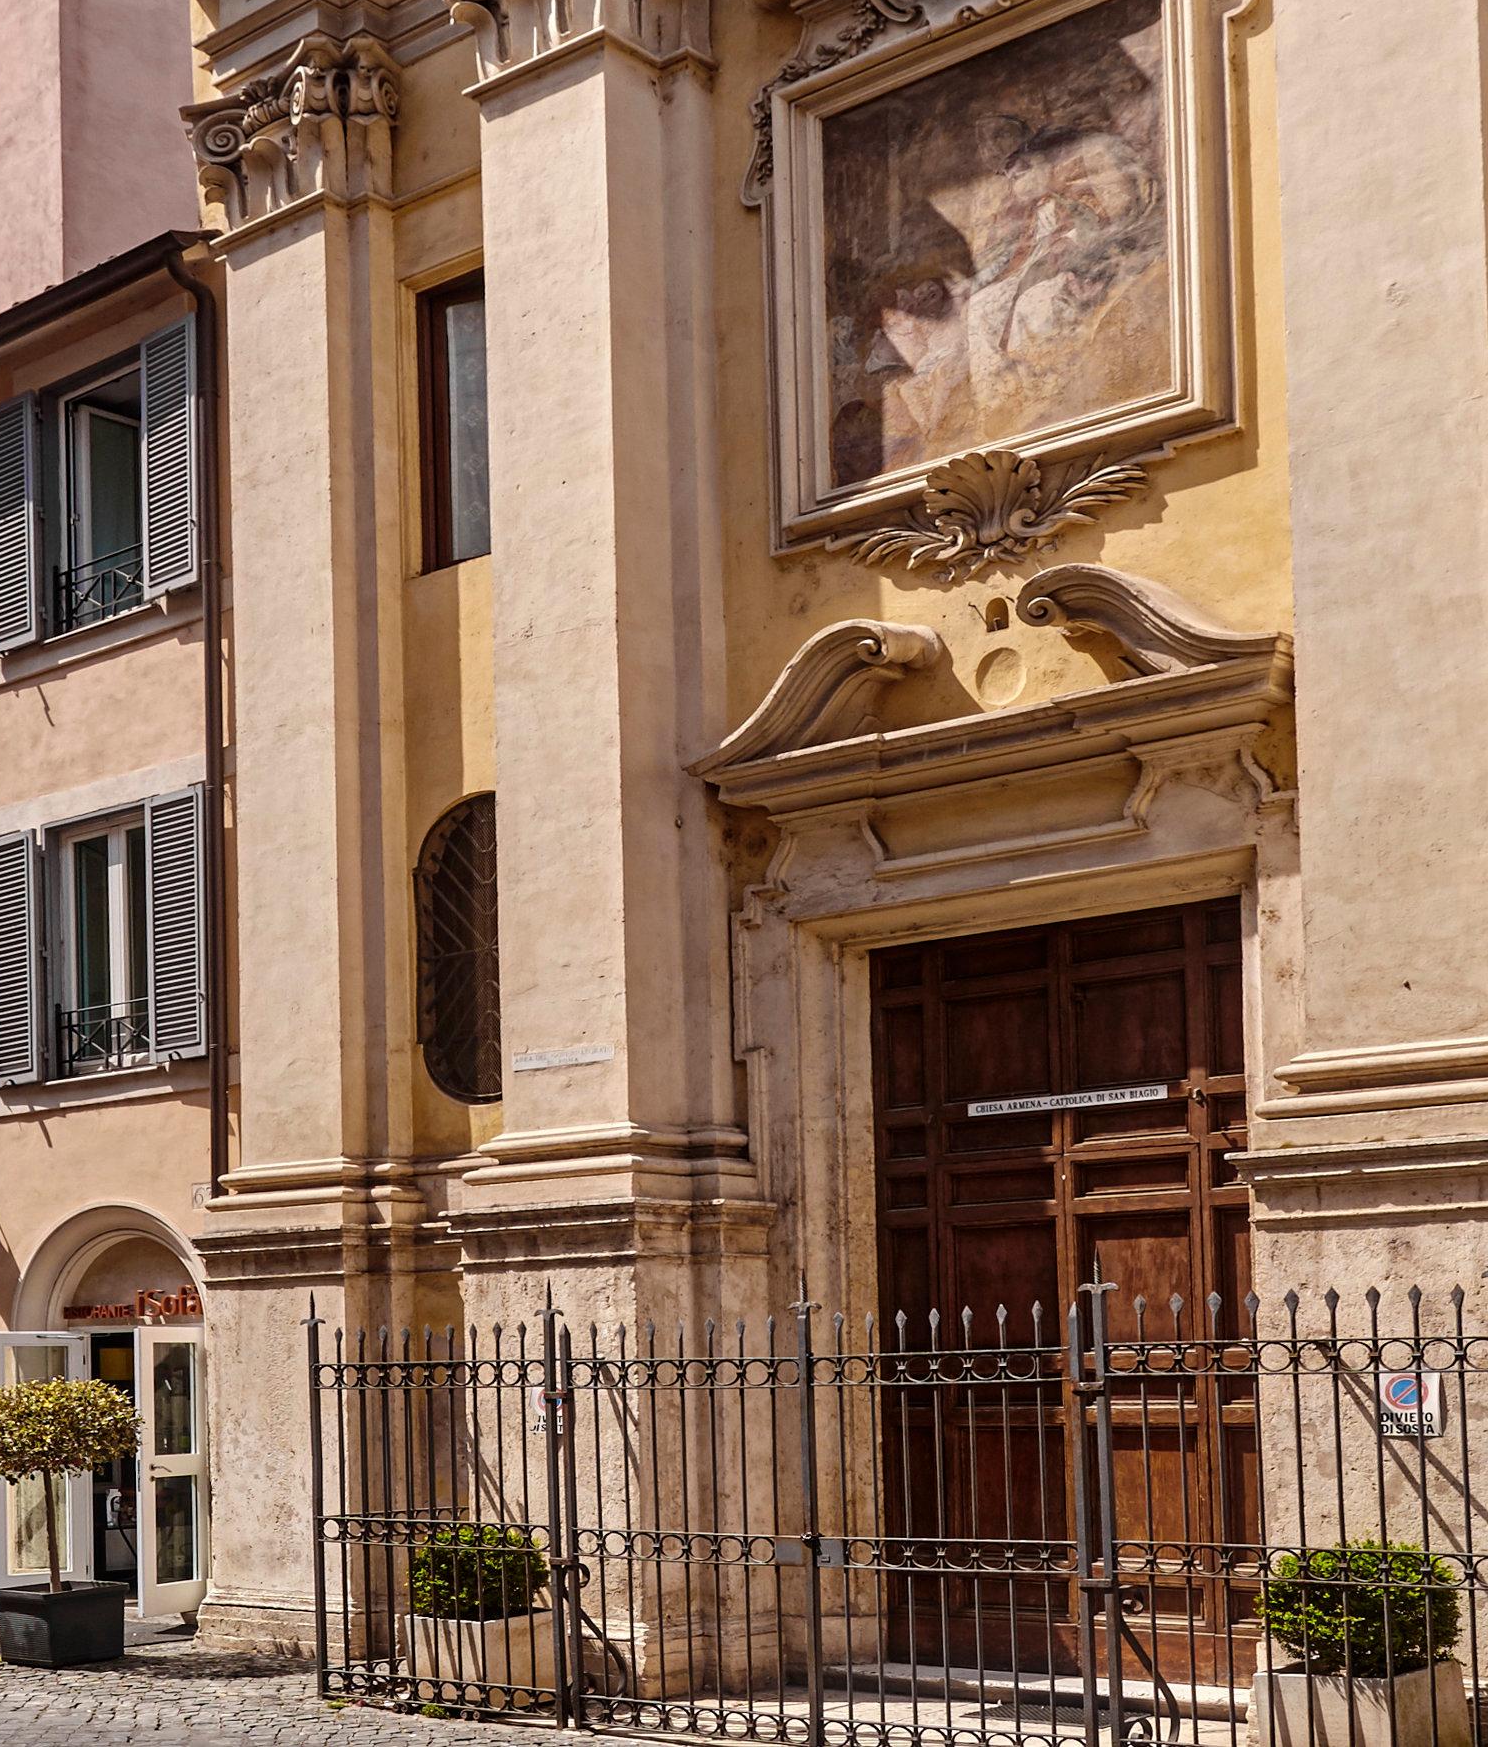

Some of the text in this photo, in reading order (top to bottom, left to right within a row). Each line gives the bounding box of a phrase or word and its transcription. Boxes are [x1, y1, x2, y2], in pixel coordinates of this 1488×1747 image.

[1096, 1094, 1105, 1102] DI
[1108, 1091, 1126, 1101] SAN
[1129, 1088, 1159, 1099] BIAGIO
[1381, 1412, 1433, 1423] DIVIEO
[1381, 1423, 1435, 1434] DI SOSA
